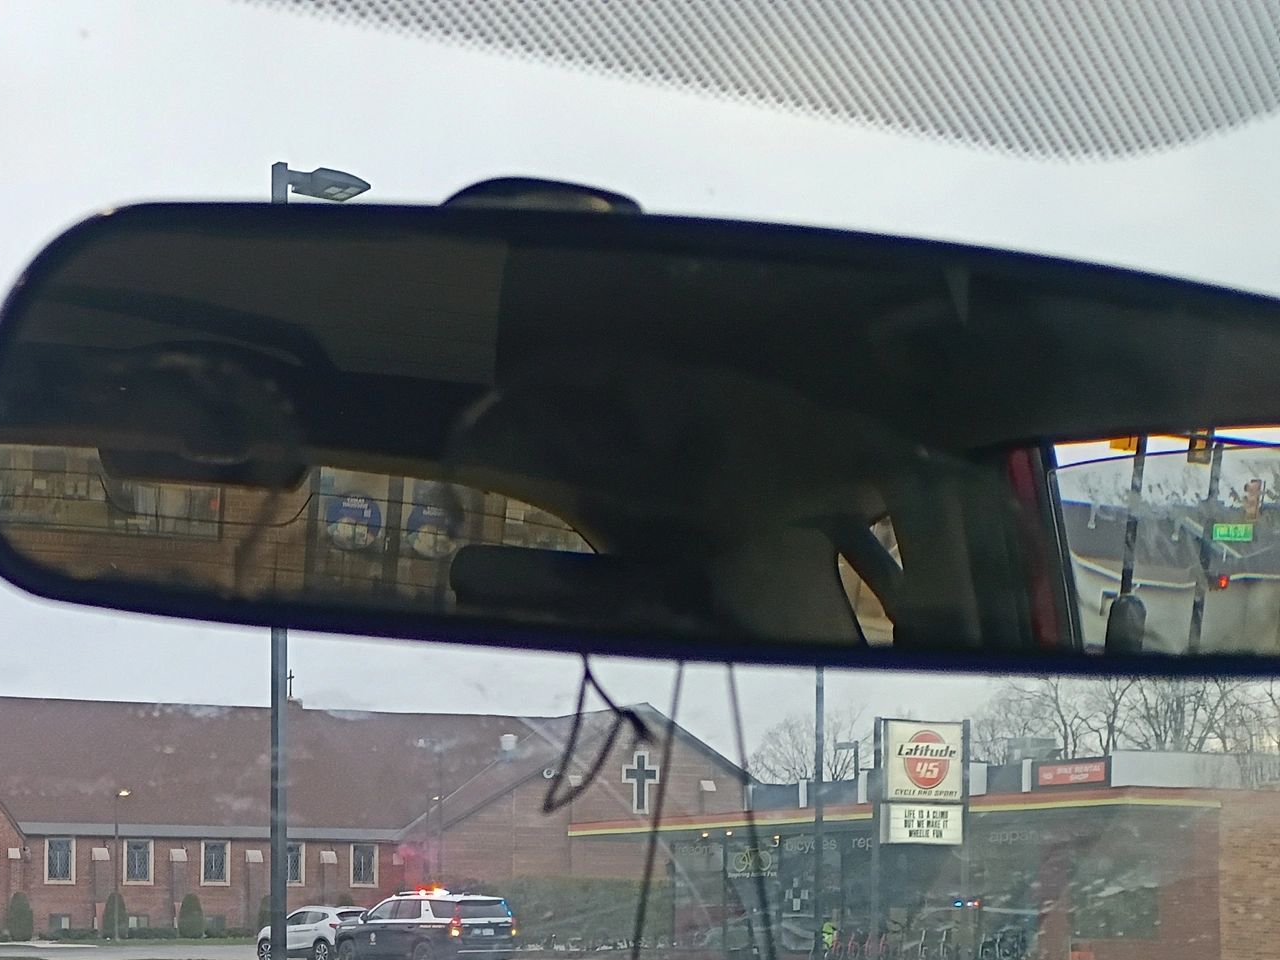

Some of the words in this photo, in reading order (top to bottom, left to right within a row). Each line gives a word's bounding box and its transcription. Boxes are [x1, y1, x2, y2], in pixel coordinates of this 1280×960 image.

[897, 744, 956, 758] Latitude
[915, 761, 940, 779] 45
[917, 789, 933, 797] AND
[904, 809, 916, 819] LIFE
[918, 809, 924, 819] IS
[932, 810, 949, 819] CLIMB
[904, 819, 915, 829] BUT
[916, 820, 925, 829] WE
[926, 820, 941, 829] MAKE
[942, 820, 949, 829] IT
[908, 829, 930, 838] WHEELIE
[932, 829, 943, 839] FUN
